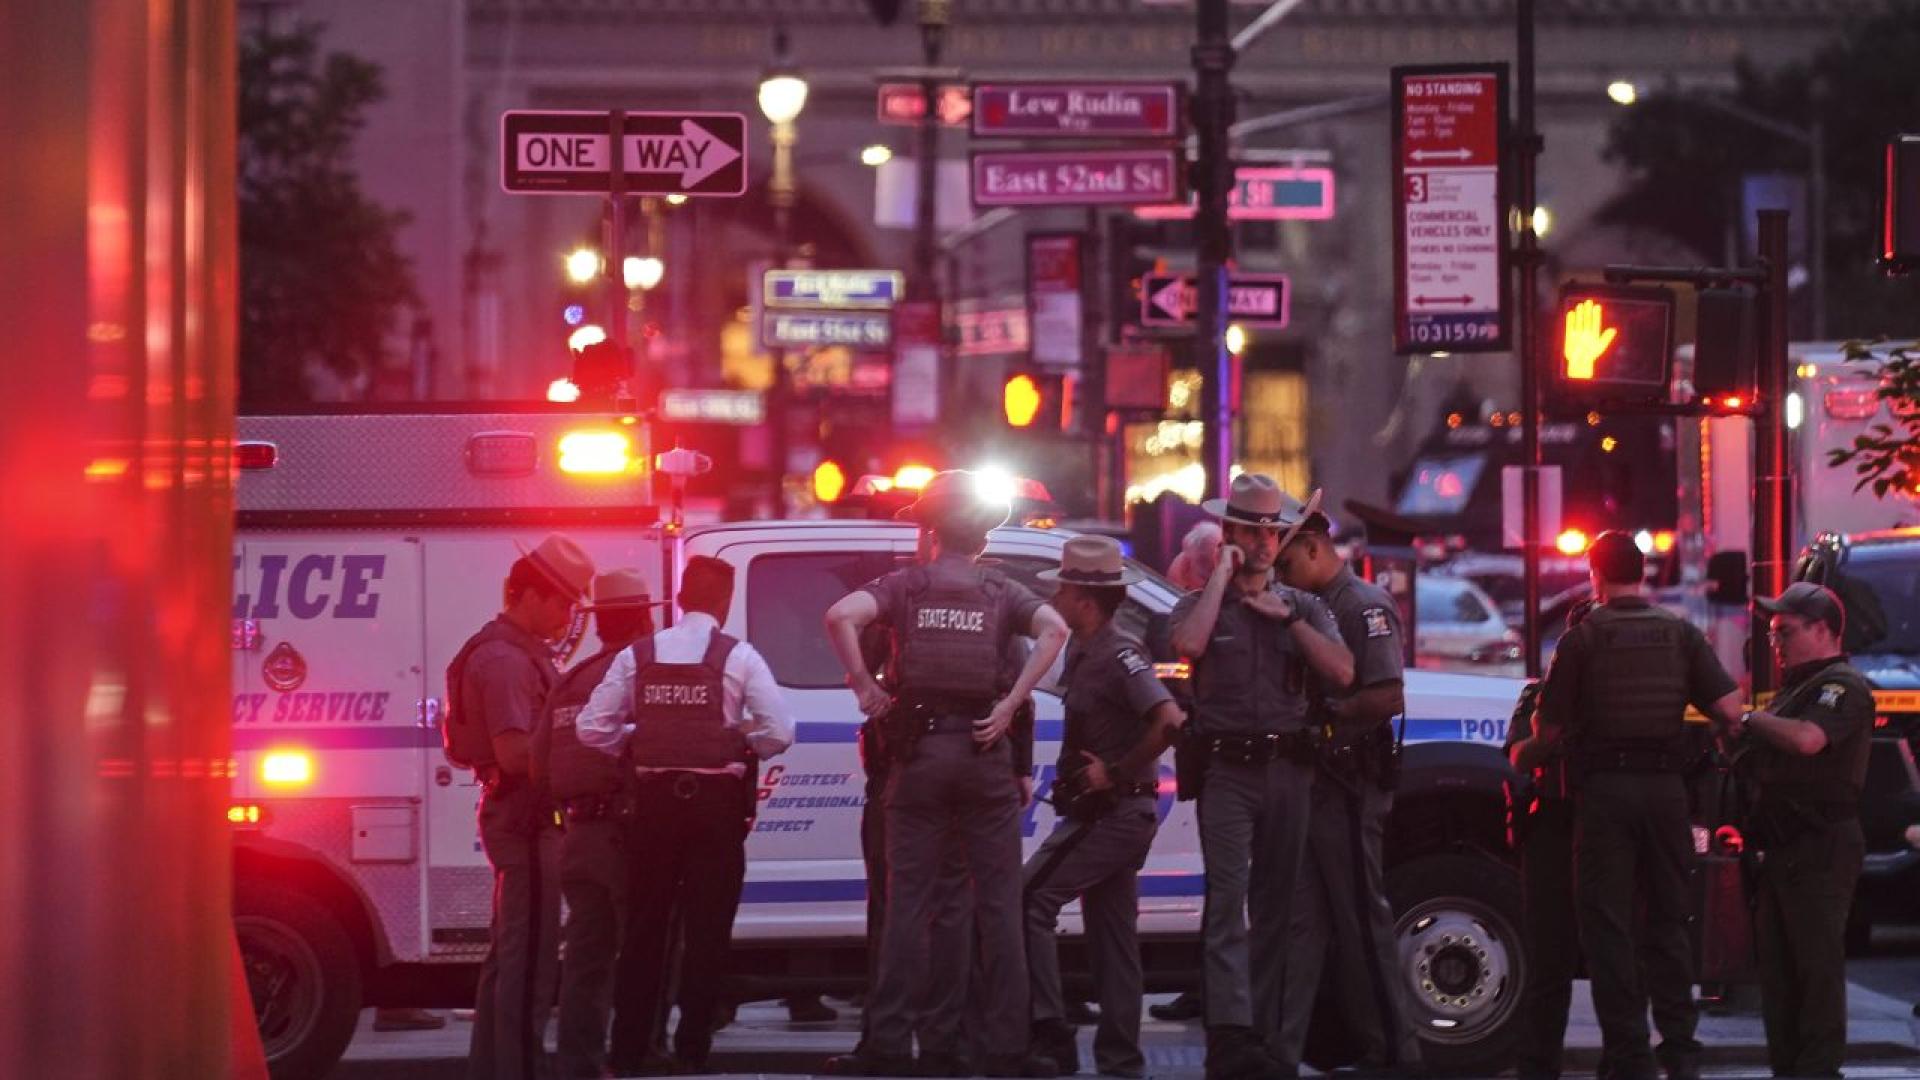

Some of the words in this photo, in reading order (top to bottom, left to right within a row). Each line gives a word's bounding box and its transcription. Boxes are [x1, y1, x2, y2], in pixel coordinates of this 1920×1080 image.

[1406, 82, 1423, 96] NO
[1425, 81, 1483, 96] STANDING
[1008, 91, 1059, 115] Lew
[1066, 90, 1141, 115] Rudin
[1059, 114, 1091, 129] Way
[525, 137, 596, 168] ONE
[636, 139, 711, 169] WAY
[986, 168, 1048, 192] East
[1056, 165, 1126, 192] 52nd
[1134, 165, 1164, 191] St
[1409, 175, 1424, 202] 3
[1409, 209, 1478, 222] COMMERCIAL
[1410, 225, 1461, 238] VEHICLES
[1463, 224, 1492, 237] ONLY
[917, 608, 948, 628] STATE
[948, 608, 985, 631] POLICE
[644, 684, 672, 705] STATE
[674, 684, 708, 705] POLICE
[272, 692, 390, 722] SERVICE
[764, 765, 850, 787] COURTESY
[749, 818, 814, 833] ESPECT
